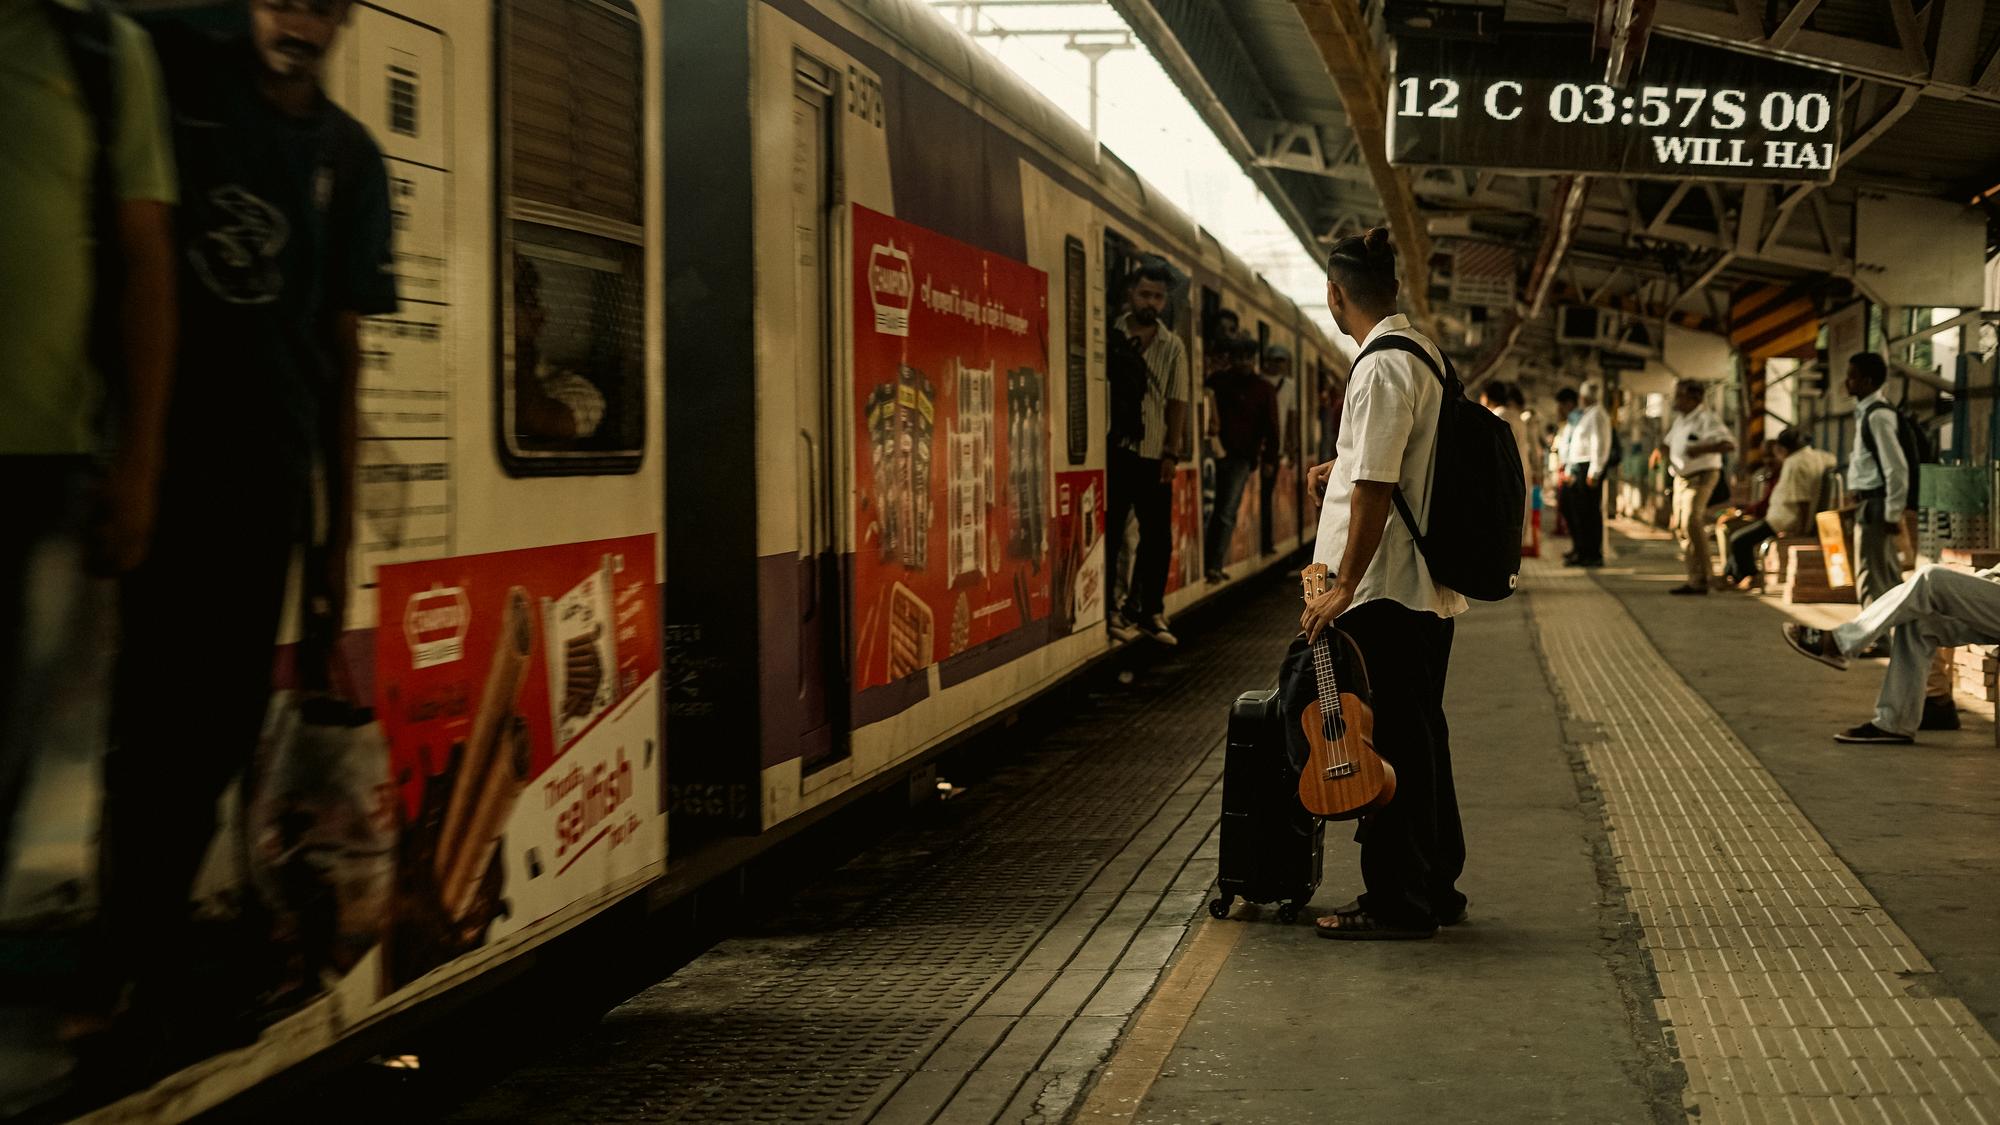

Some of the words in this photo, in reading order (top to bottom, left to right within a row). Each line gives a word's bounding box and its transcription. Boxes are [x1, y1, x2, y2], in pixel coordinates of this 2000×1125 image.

[1397, 77, 1460, 118] 12
[1484, 81, 1523, 120] C
[1759, 91, 1831, 133] 00
[1652, 135, 1754, 167] WILL
[556, 746, 632, 855] selfish
